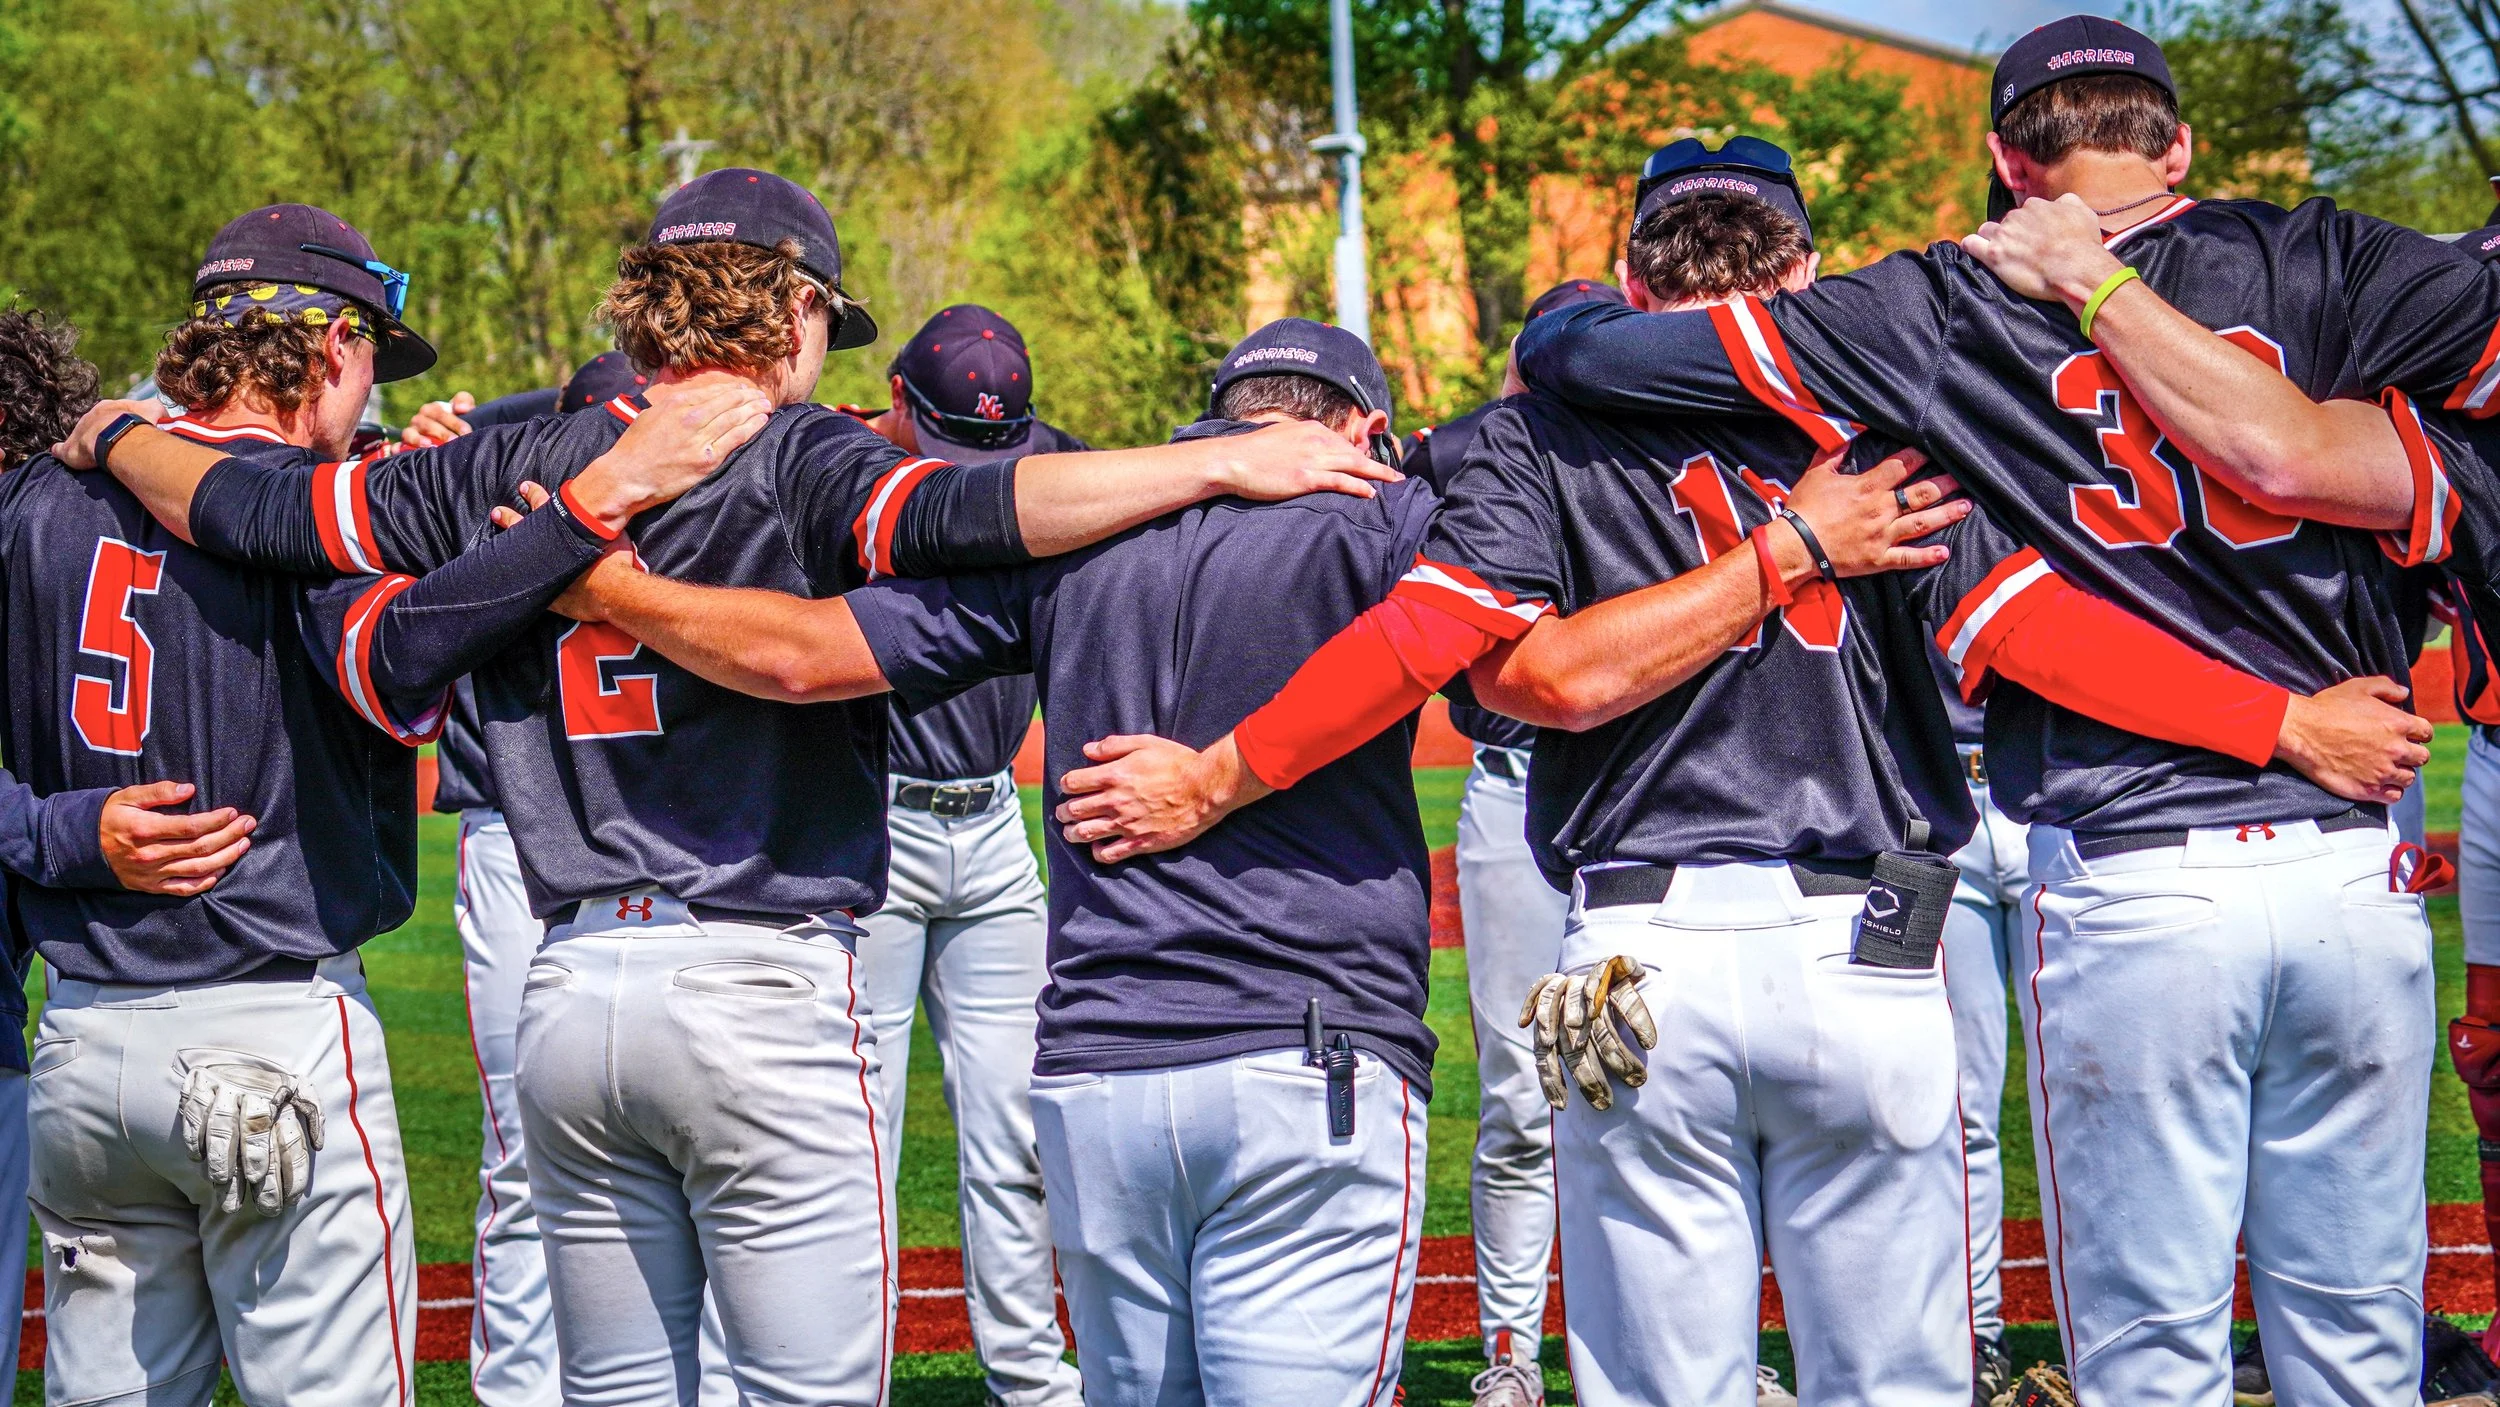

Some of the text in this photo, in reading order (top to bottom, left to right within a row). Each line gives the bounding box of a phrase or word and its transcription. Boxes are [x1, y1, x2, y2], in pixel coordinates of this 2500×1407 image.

[2047, 48, 2136, 70] HARRIERS
[1670, 177, 1758, 195] HARRIERS
[658, 221, 737, 243] HARRIERS
[1233, 347, 1319, 369] HARRIERS
[70, 536, 168, 757] 5
[557, 541, 664, 741] 2
